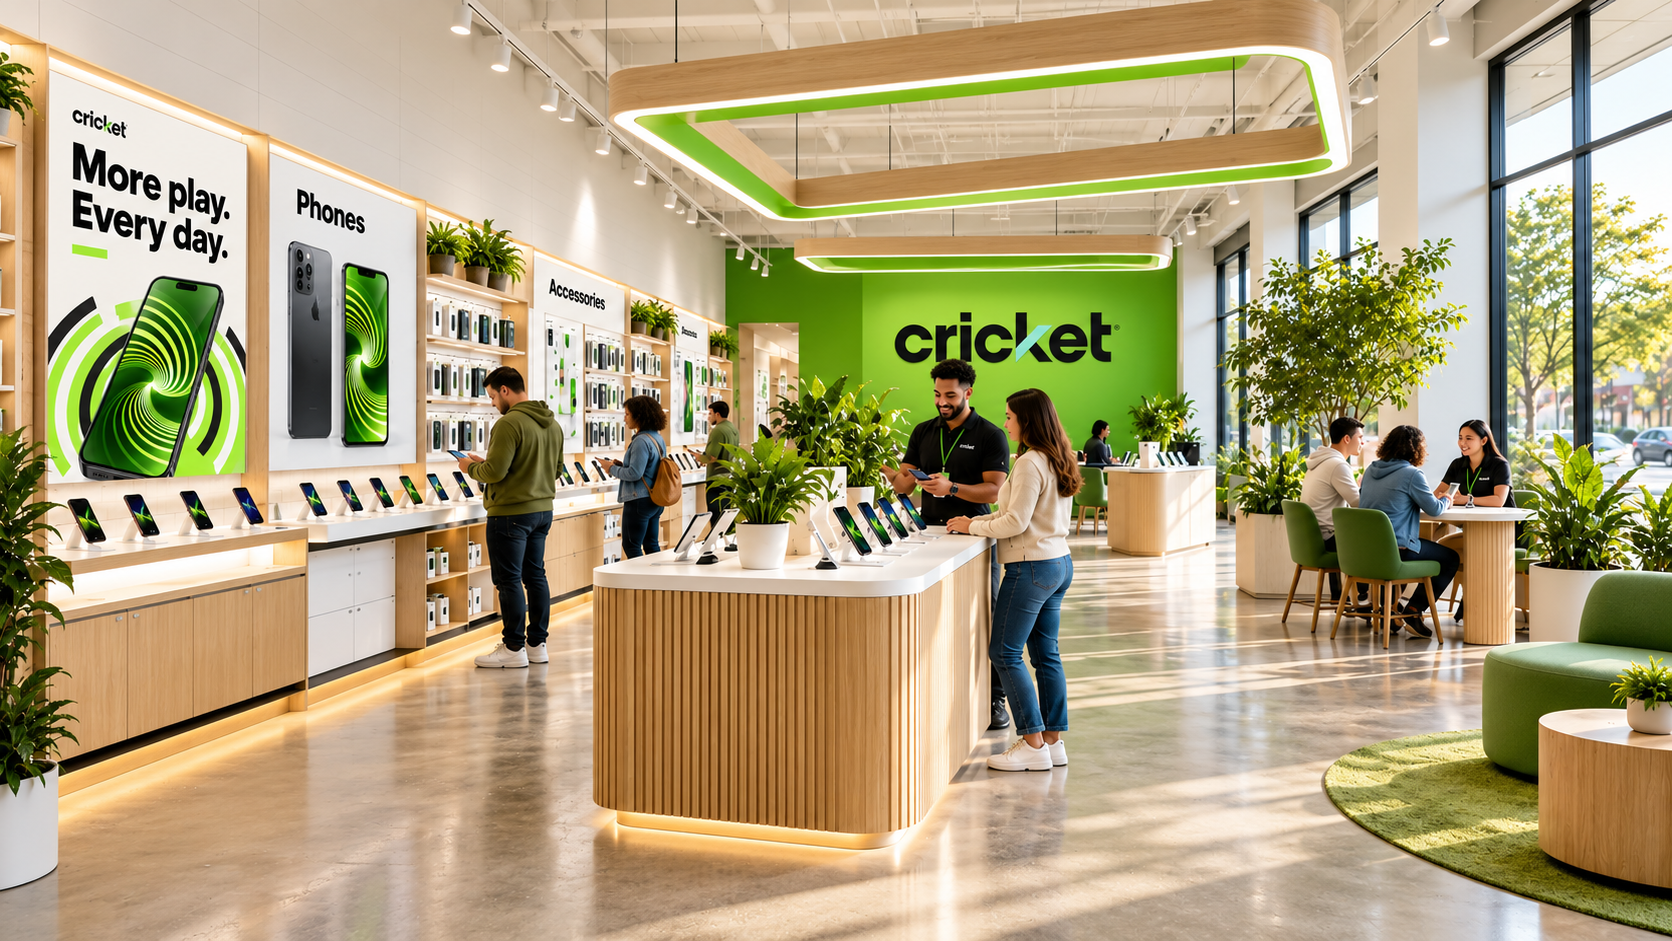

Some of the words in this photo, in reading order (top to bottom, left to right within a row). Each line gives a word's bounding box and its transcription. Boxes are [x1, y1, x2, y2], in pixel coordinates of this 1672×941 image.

[72, 109, 127, 138] cricket
[72, 141, 162, 201] More
[168, 177, 230, 225] play.
[72, 189, 167, 253] Every
[173, 217, 228, 264] day.
[296, 189, 366, 234] Phones
[548, 278, 606, 311] Accessories
